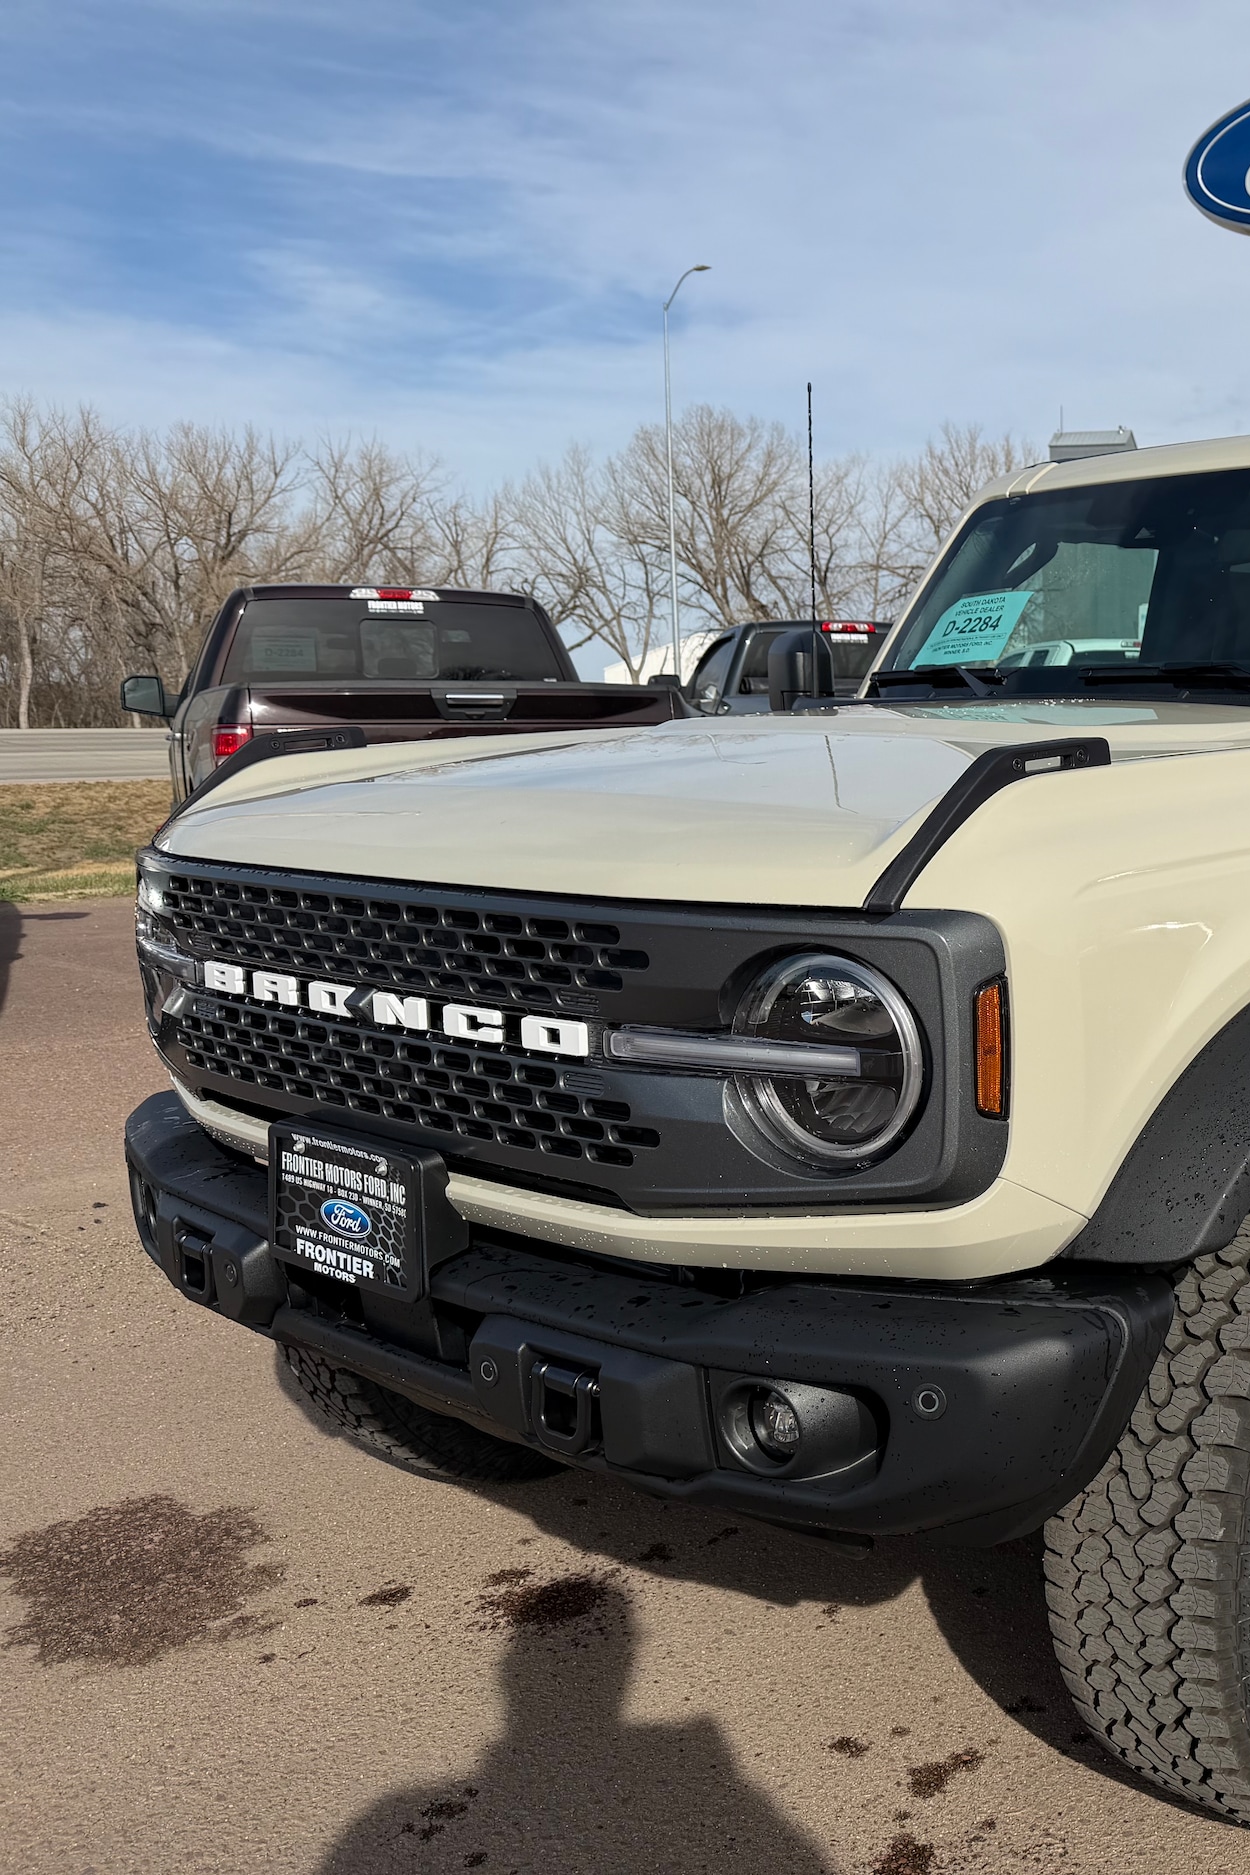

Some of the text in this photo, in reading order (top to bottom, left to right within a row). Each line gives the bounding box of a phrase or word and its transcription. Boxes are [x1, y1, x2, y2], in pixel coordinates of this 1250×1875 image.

[955, 605, 1004, 616] VEHICLE DEALER
[961, 597, 1006, 608] SOUTH DAKOTA
[942, 614, 1003, 637] D-2284
[204, 960, 590, 1057] BRONCO
[281, 1151, 324, 1180] FRONTIER
[325, 1163, 363, 1192] MOTORS
[363, 1174, 389, 1203] FORD,
[295, 1176, 303, 1185] US
[303, 1178, 326, 1192] HIGHWAY
[327, 1184, 334, 1195] 18
[337, 1187, 348, 1199] BOX
[331, 1204, 361, 1232] Ford
[295, 1224, 400, 1268] WWW.FRONTIERMOTORS.COM
[296, 1238, 374, 1279] FRONTIER
[313, 1261, 356, 1284] MOTORS
